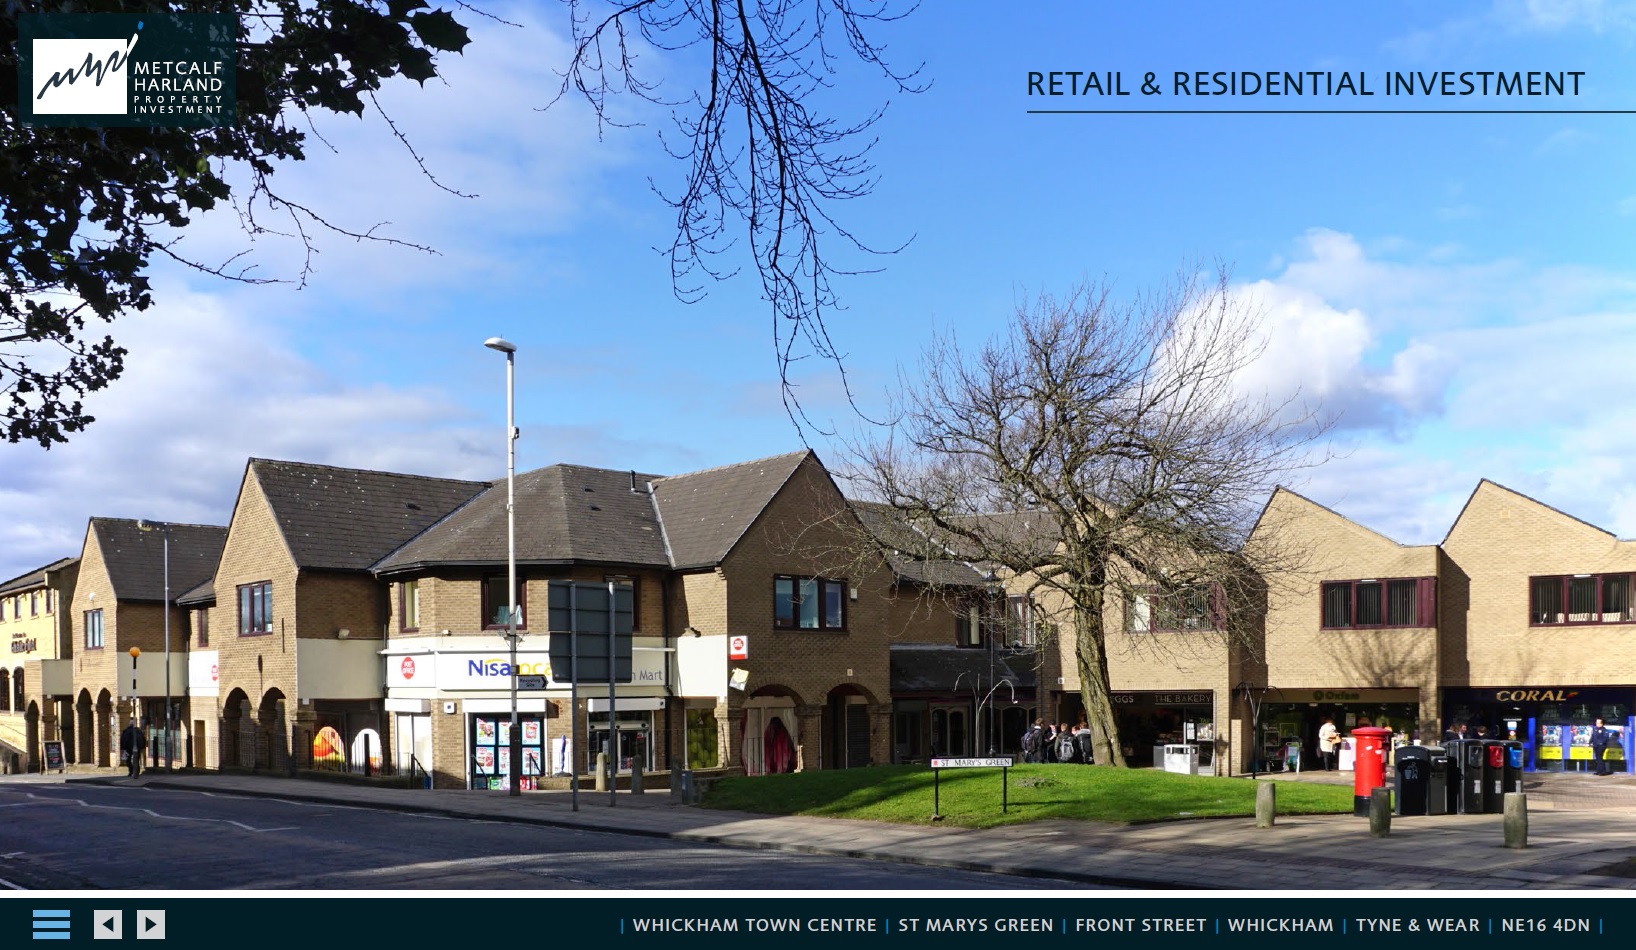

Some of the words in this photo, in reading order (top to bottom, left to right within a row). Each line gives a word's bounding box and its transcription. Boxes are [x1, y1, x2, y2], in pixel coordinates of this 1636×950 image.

[468, 658, 512, 677] Nisa
[639, 669, 663, 681] Mart
[1154, 694, 1172, 703] THE
[1175, 694, 1212, 703] BAKERY
[1496, 690, 1567, 702] CORAL
[954, 759, 982, 767] MARY'S
